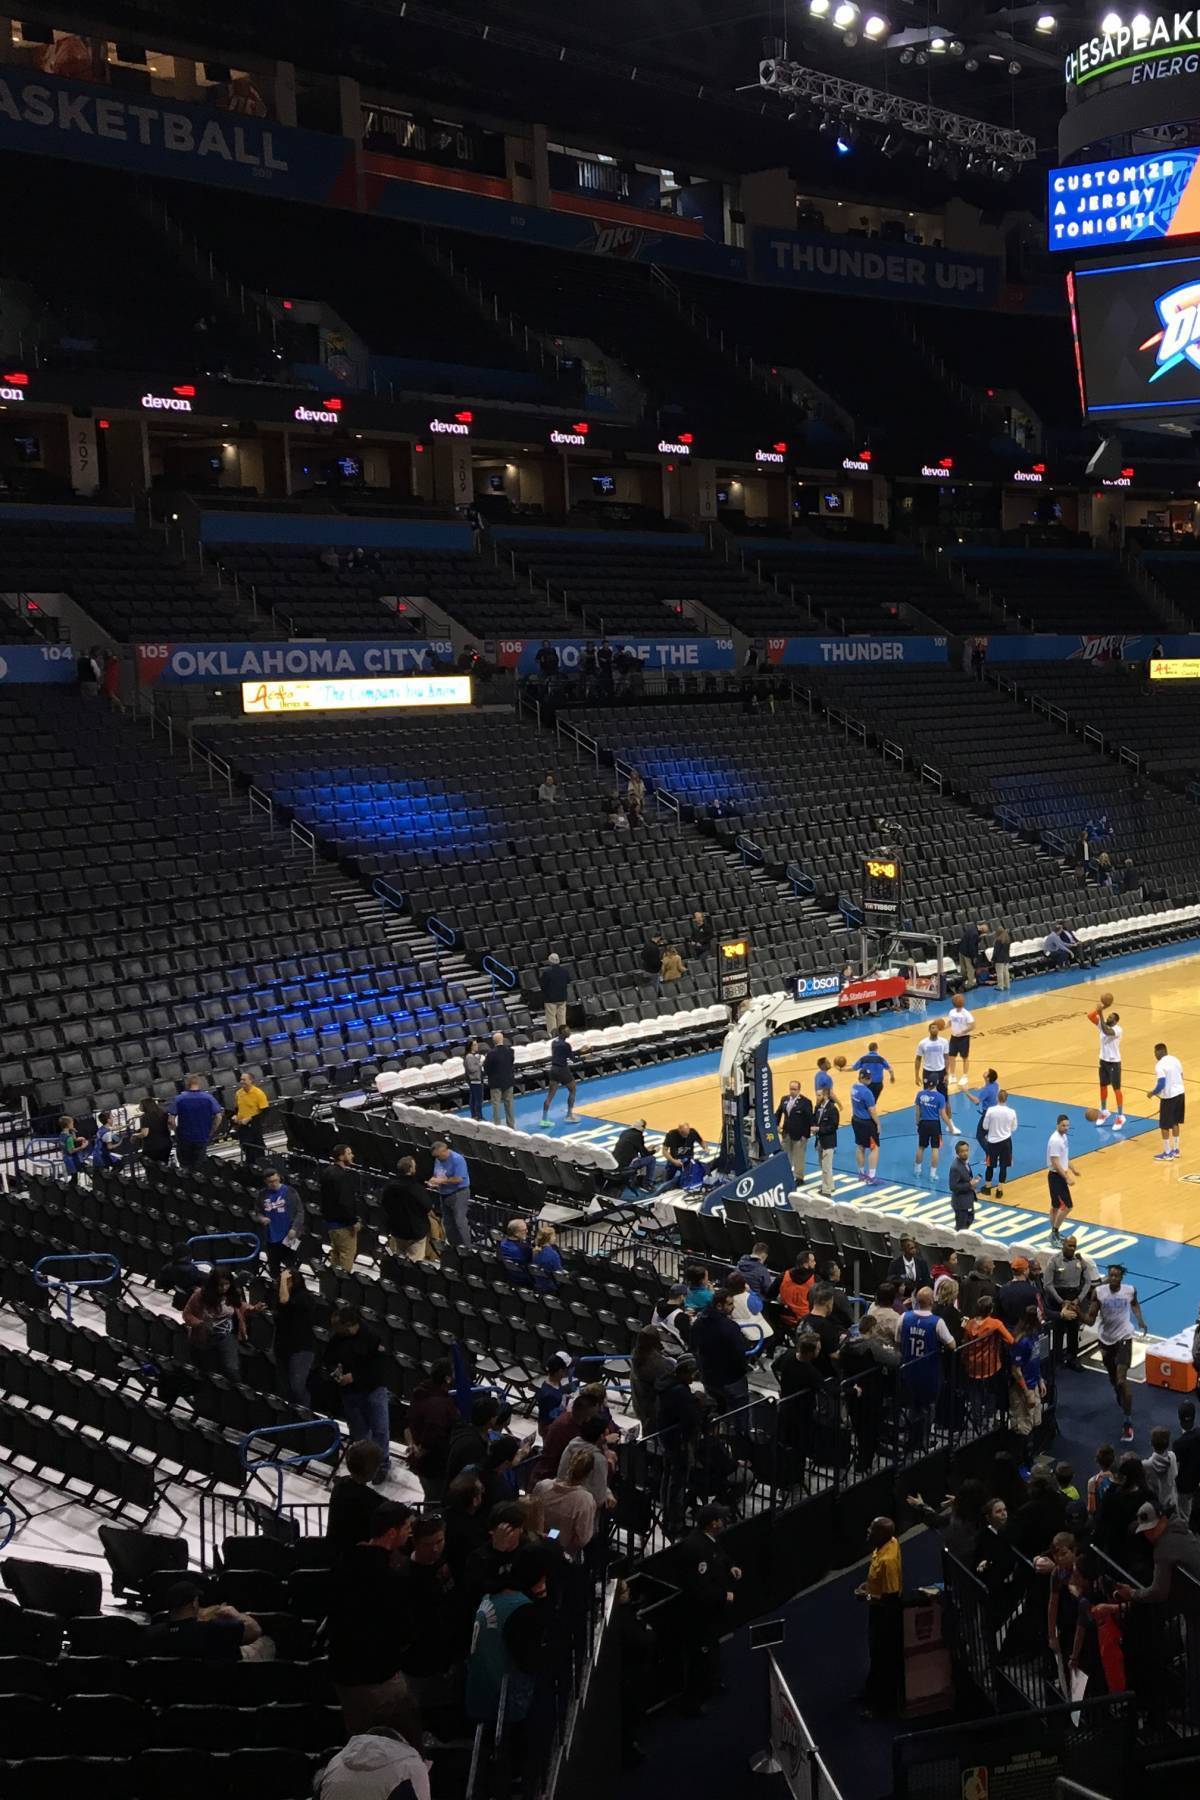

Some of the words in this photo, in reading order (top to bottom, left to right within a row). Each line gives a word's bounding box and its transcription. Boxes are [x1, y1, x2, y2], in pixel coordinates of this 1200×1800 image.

[1054, 201, 1066, 216] A
[1077, 187, 1155, 214] JERSEY
[770, 241, 926, 286] THUNDER
[935, 264, 985, 293] UP!
[141, 393, 192, 412] devon
[294, 407, 339, 424] devon
[430, 419, 469, 435] devon
[550, 430, 585, 446] devon
[658, 440, 690, 455] devon
[755, 450, 784, 464] devon
[842, 458, 869, 471] devon
[921, 465, 950, 478] devon
[1014, 470, 1042, 482] devon
[41, 646, 73, 662] 104
[500, 642, 523, 654] 106
[655, 645, 700, 665] THE
[715, 639, 734, 650] 106
[768, 639, 785, 652] 107
[820, 643, 904, 662] THUNDER
[933, 638, 948, 648] 107
[140, 645, 169, 659] 105
[171, 648, 356, 677] OKLAHOMA
[364, 646, 427, 673] CITY
[873, 904, 897, 912] TISSOT
[797, 975, 839, 993] Dobson
[761, 1066, 772, 1130] DRAFTKINGS
[909, 1337, 925, 1357] 12
